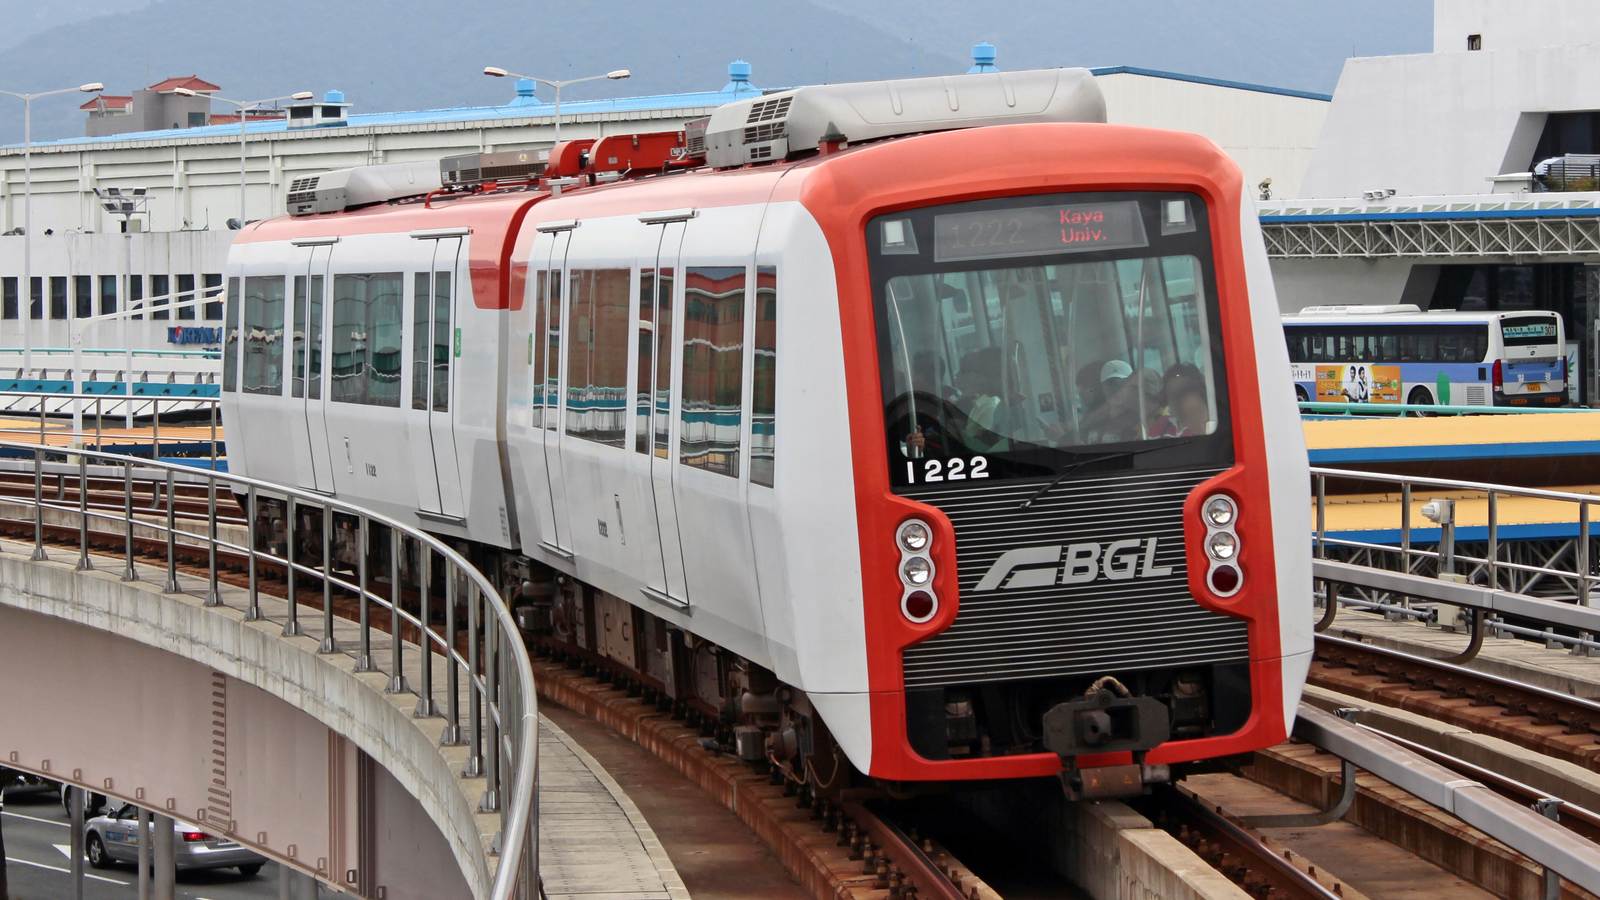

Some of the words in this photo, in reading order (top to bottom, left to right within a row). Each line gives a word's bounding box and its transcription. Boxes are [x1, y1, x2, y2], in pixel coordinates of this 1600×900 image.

[1059, 209, 1104, 225] Kaya
[951, 219, 1024, 249] 1222
[1060, 227, 1107, 244] Univ.
[906, 455, 990, 484] 1222
[1061, 537, 1173, 584] BGL
